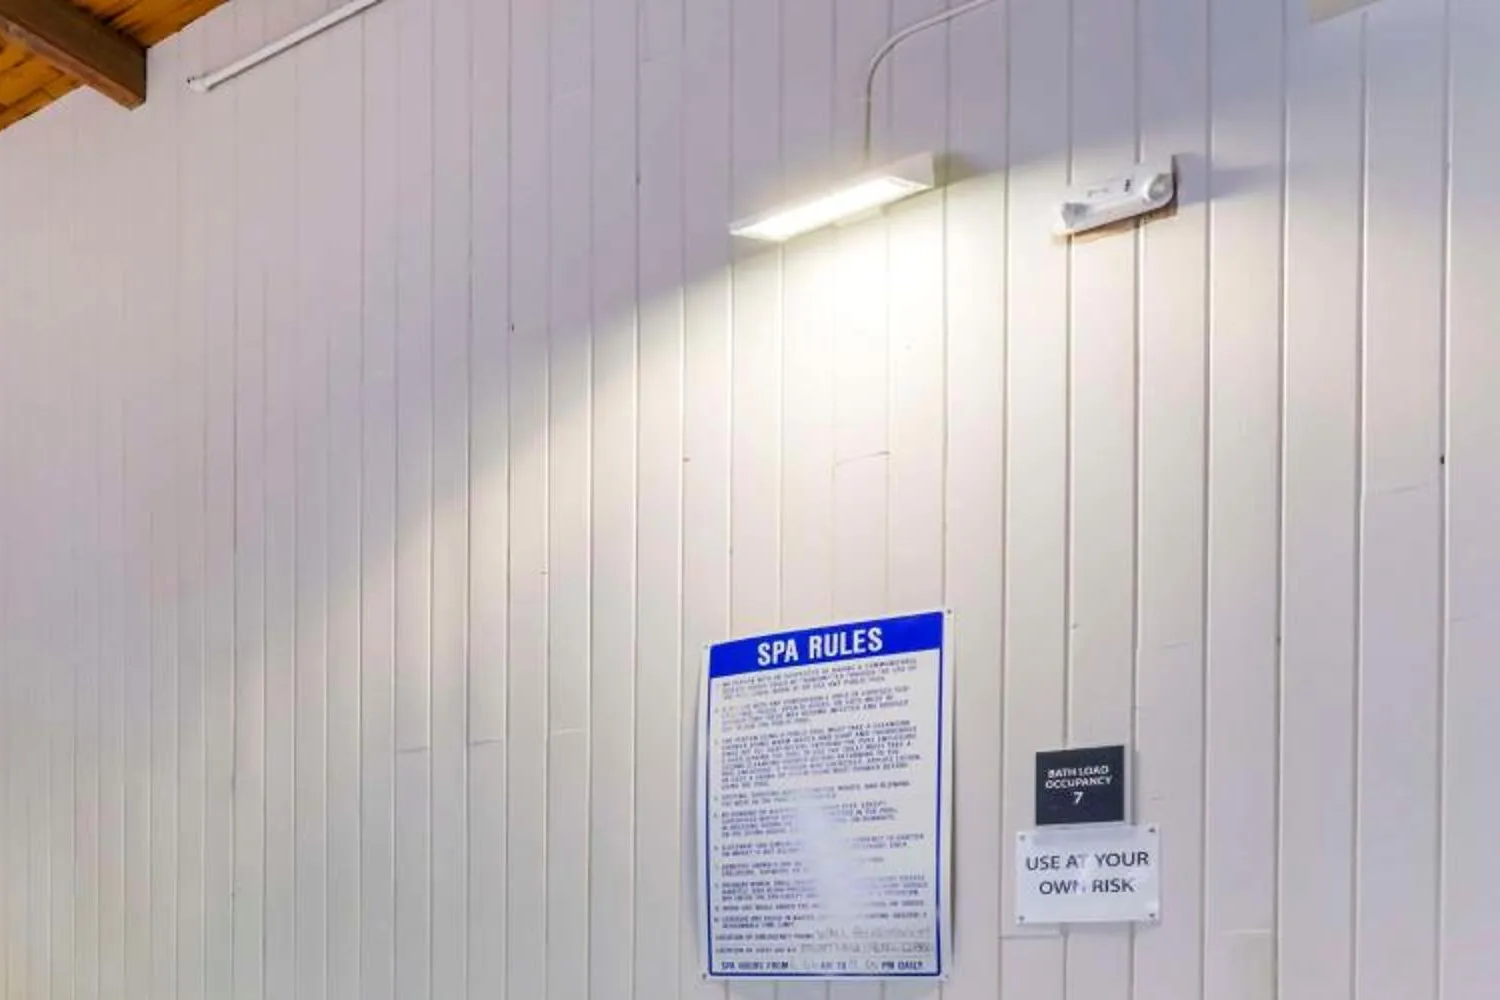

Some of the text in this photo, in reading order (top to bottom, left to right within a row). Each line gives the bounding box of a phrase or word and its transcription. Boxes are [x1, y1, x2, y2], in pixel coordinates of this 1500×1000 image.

[757, 627, 883, 666] SPA RULES
[1047, 765, 1109, 778] BATH LOAD
[1045, 774, 1113, 789] OCCUPANCY
[1073, 791, 1084, 805] 7
[1026, 851, 1149, 871] USE AT YOUR
[1092, 878, 1135, 893] RISK
